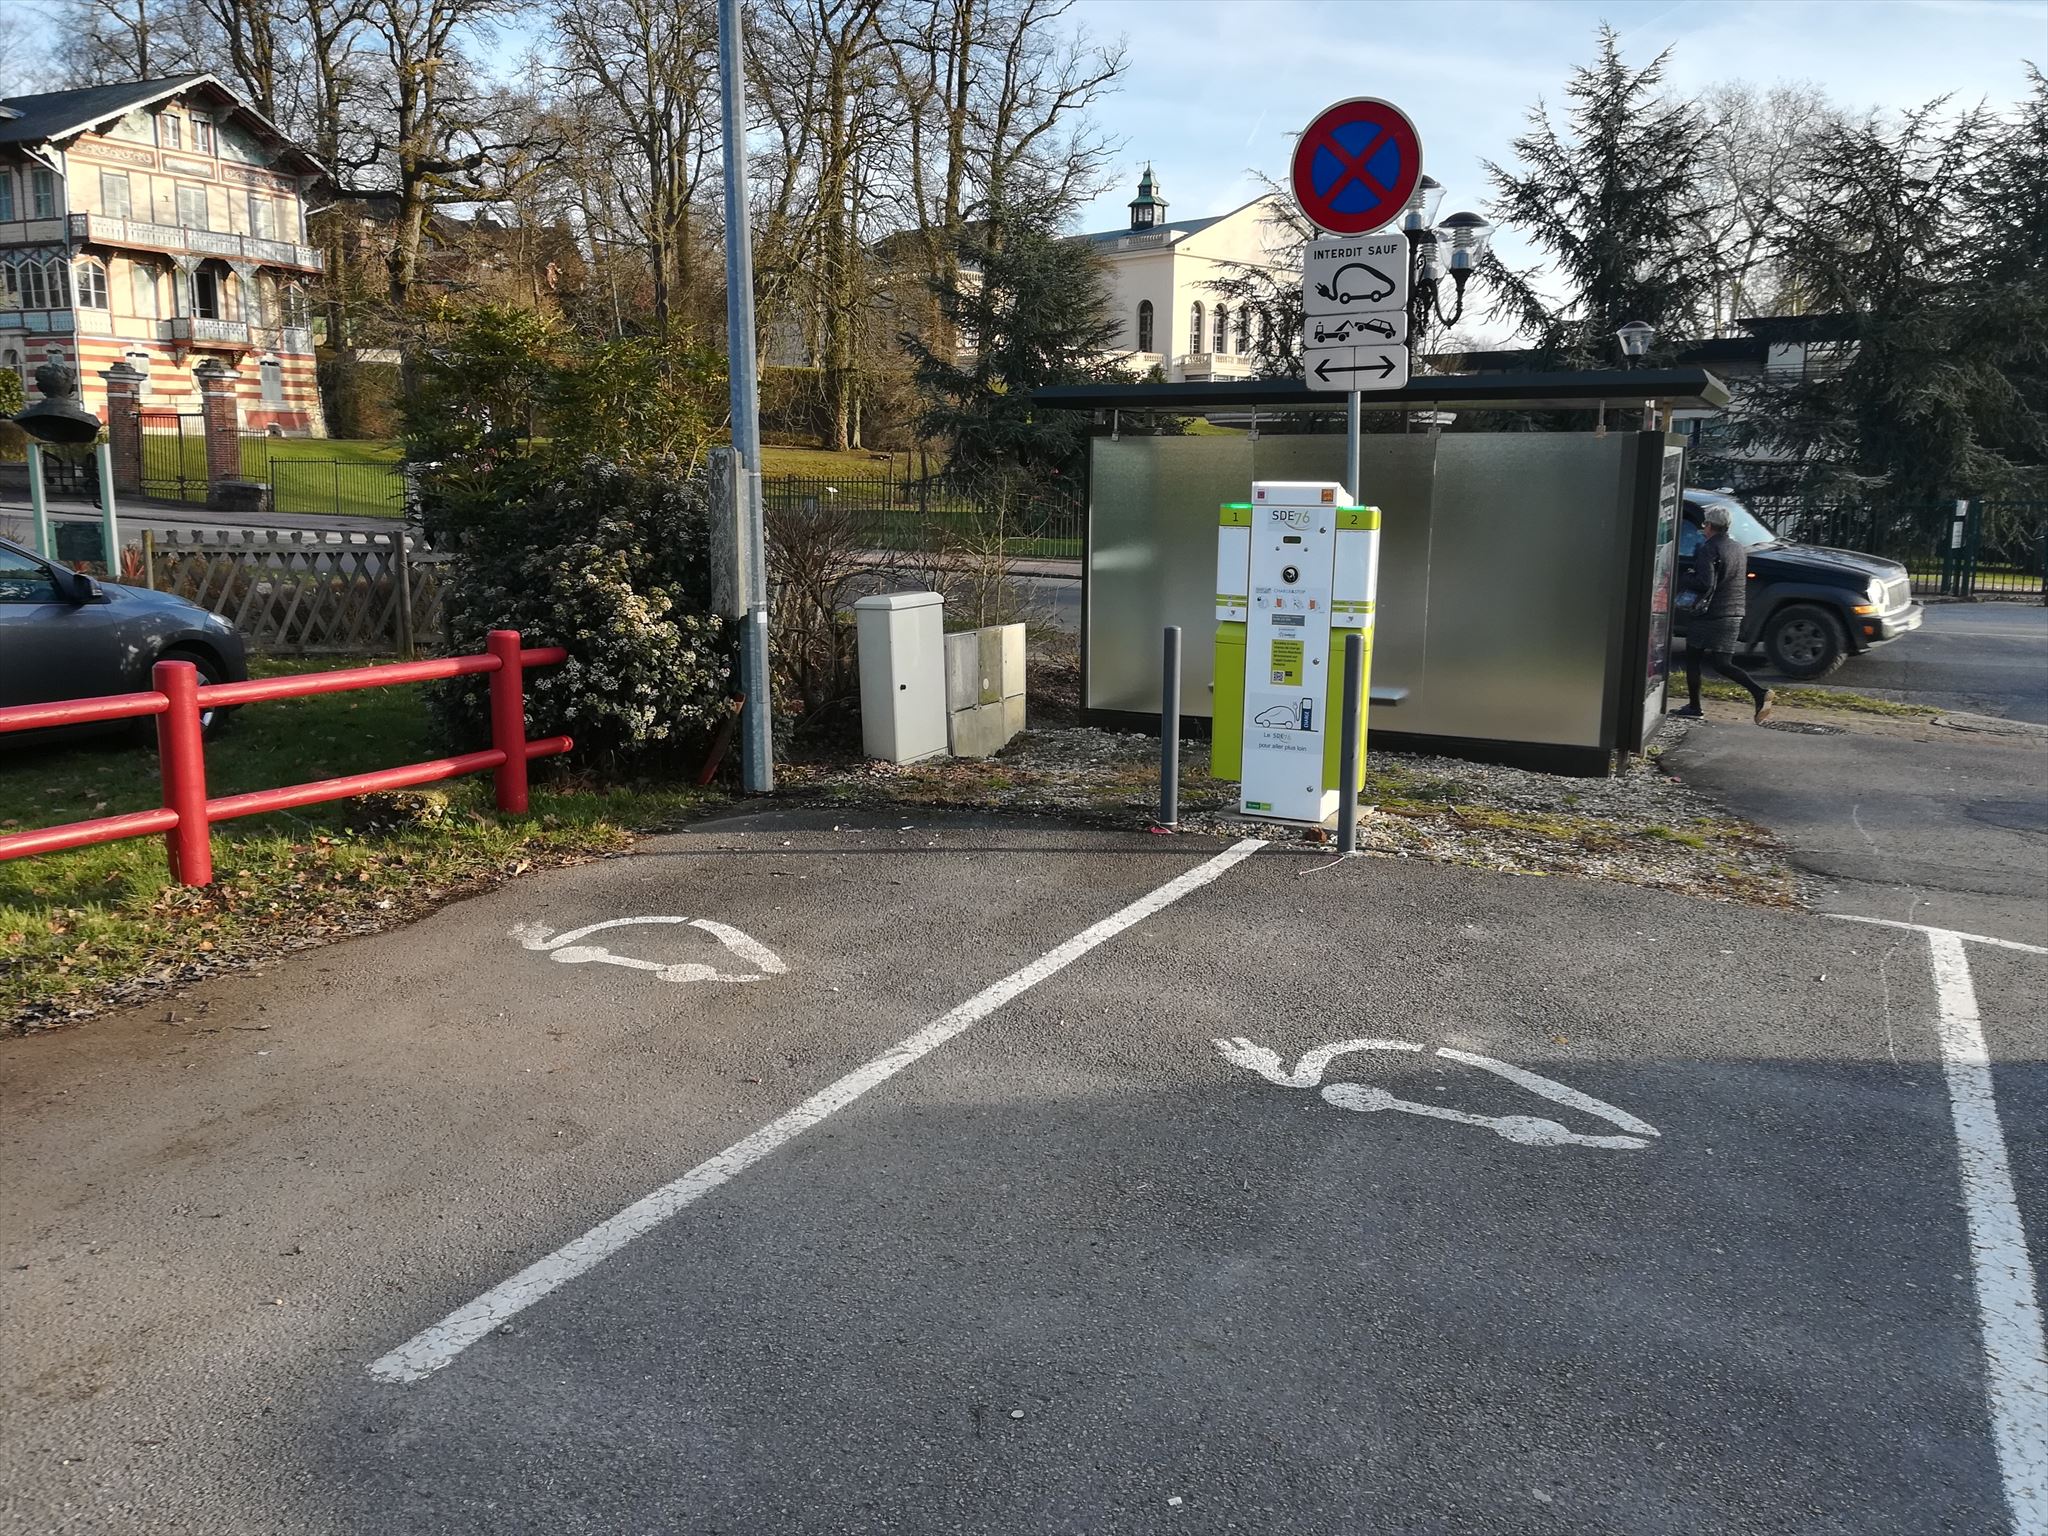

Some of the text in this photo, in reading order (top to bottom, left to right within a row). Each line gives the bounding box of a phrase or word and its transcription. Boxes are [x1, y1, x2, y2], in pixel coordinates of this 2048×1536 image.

[1314, 244, 1398, 260] INTERDIT SAUF
[1232, 512, 1239, 522] 1
[1272, 510, 1310, 525] SDE76
[1350, 514, 1358, 525] 2
